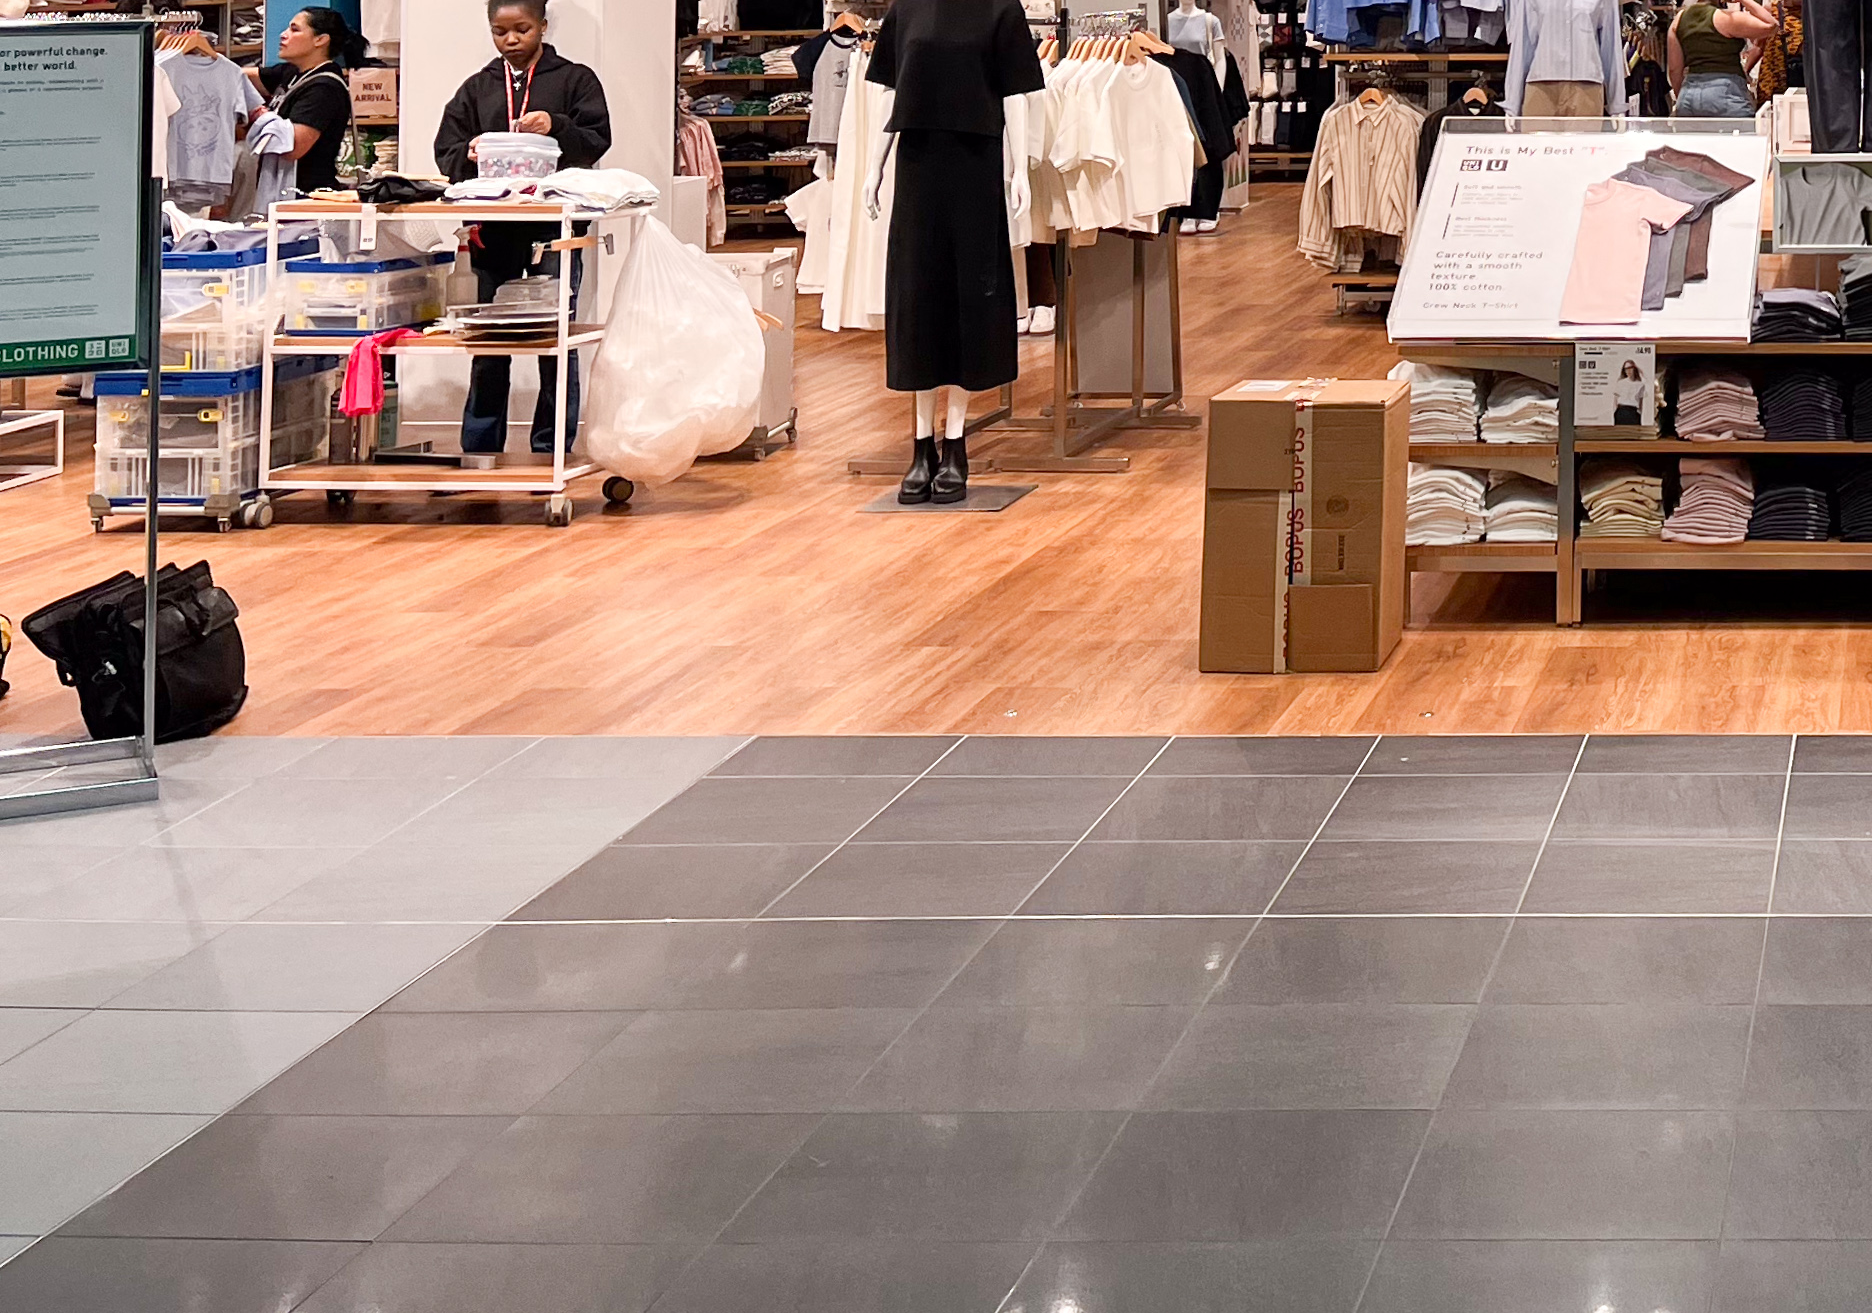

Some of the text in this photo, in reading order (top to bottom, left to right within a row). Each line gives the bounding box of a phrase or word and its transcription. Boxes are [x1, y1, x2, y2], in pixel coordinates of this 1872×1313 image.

[14, 47, 64, 58] powerful
[66, 47, 108, 57] change.
[4, 60, 78, 71] better world.
[363, 83, 383, 91] NEW
[354, 93, 392, 102] ARRIVAL
[1466, 146, 1574, 157] This is My Best
[1490, 160, 1504, 170] U
[1435, 251, 1544, 261] Carefully crafted
[1478, 262, 1523, 270] smooth
[1430, 272, 1476, 280] texture
[1429, 283, 1457, 291] 100%
[0, 344, 79, 362] LOTHING
[1293, 508, 1305, 574] BOPUS
